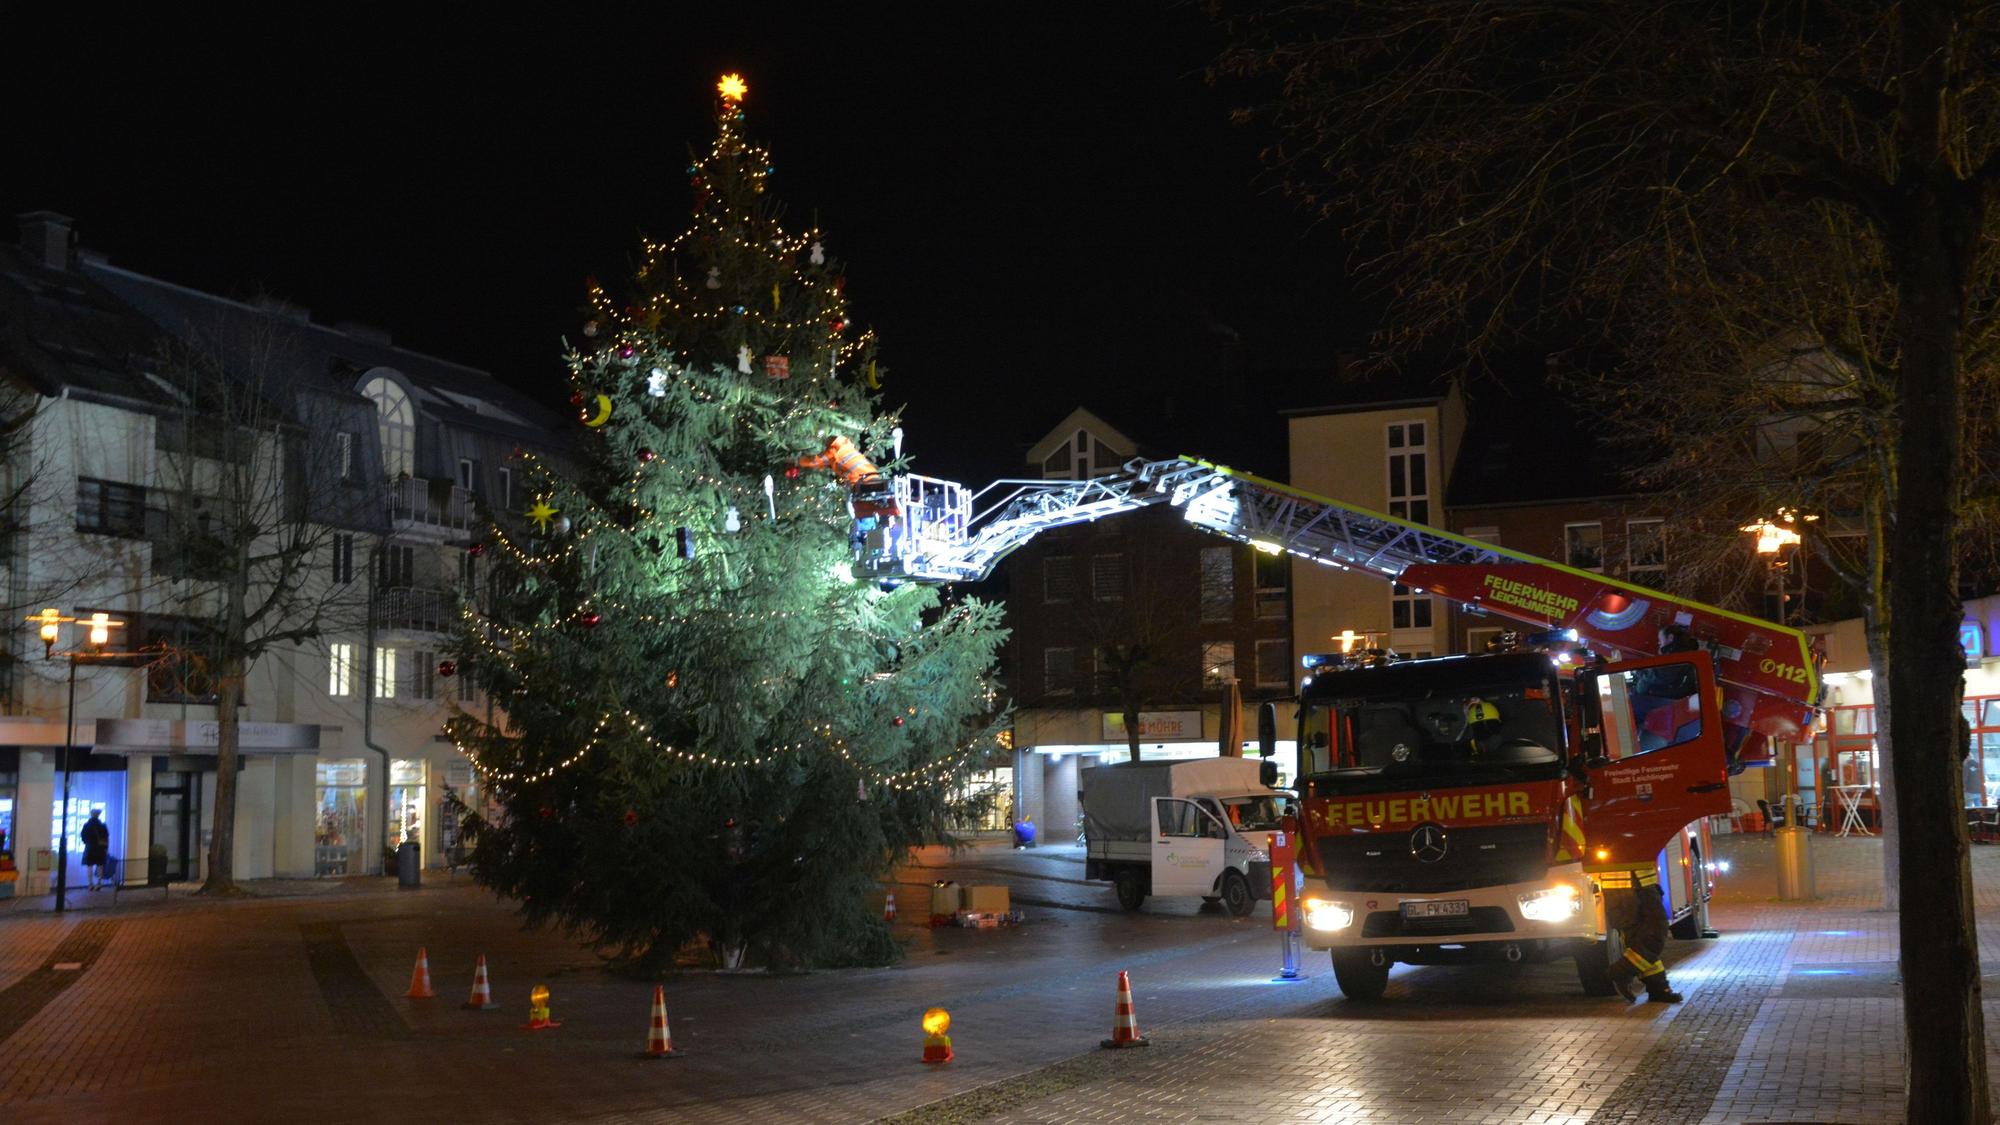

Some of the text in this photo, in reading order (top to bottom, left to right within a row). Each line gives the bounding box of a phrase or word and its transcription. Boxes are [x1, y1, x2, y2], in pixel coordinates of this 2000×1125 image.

[1484, 574, 1579, 611] FEUERWEHR
[1489, 590, 1566, 619] LEICHLINGEN
[1776, 663, 1806, 683] 112
[1327, 791, 1530, 826] FEUERWEHR
